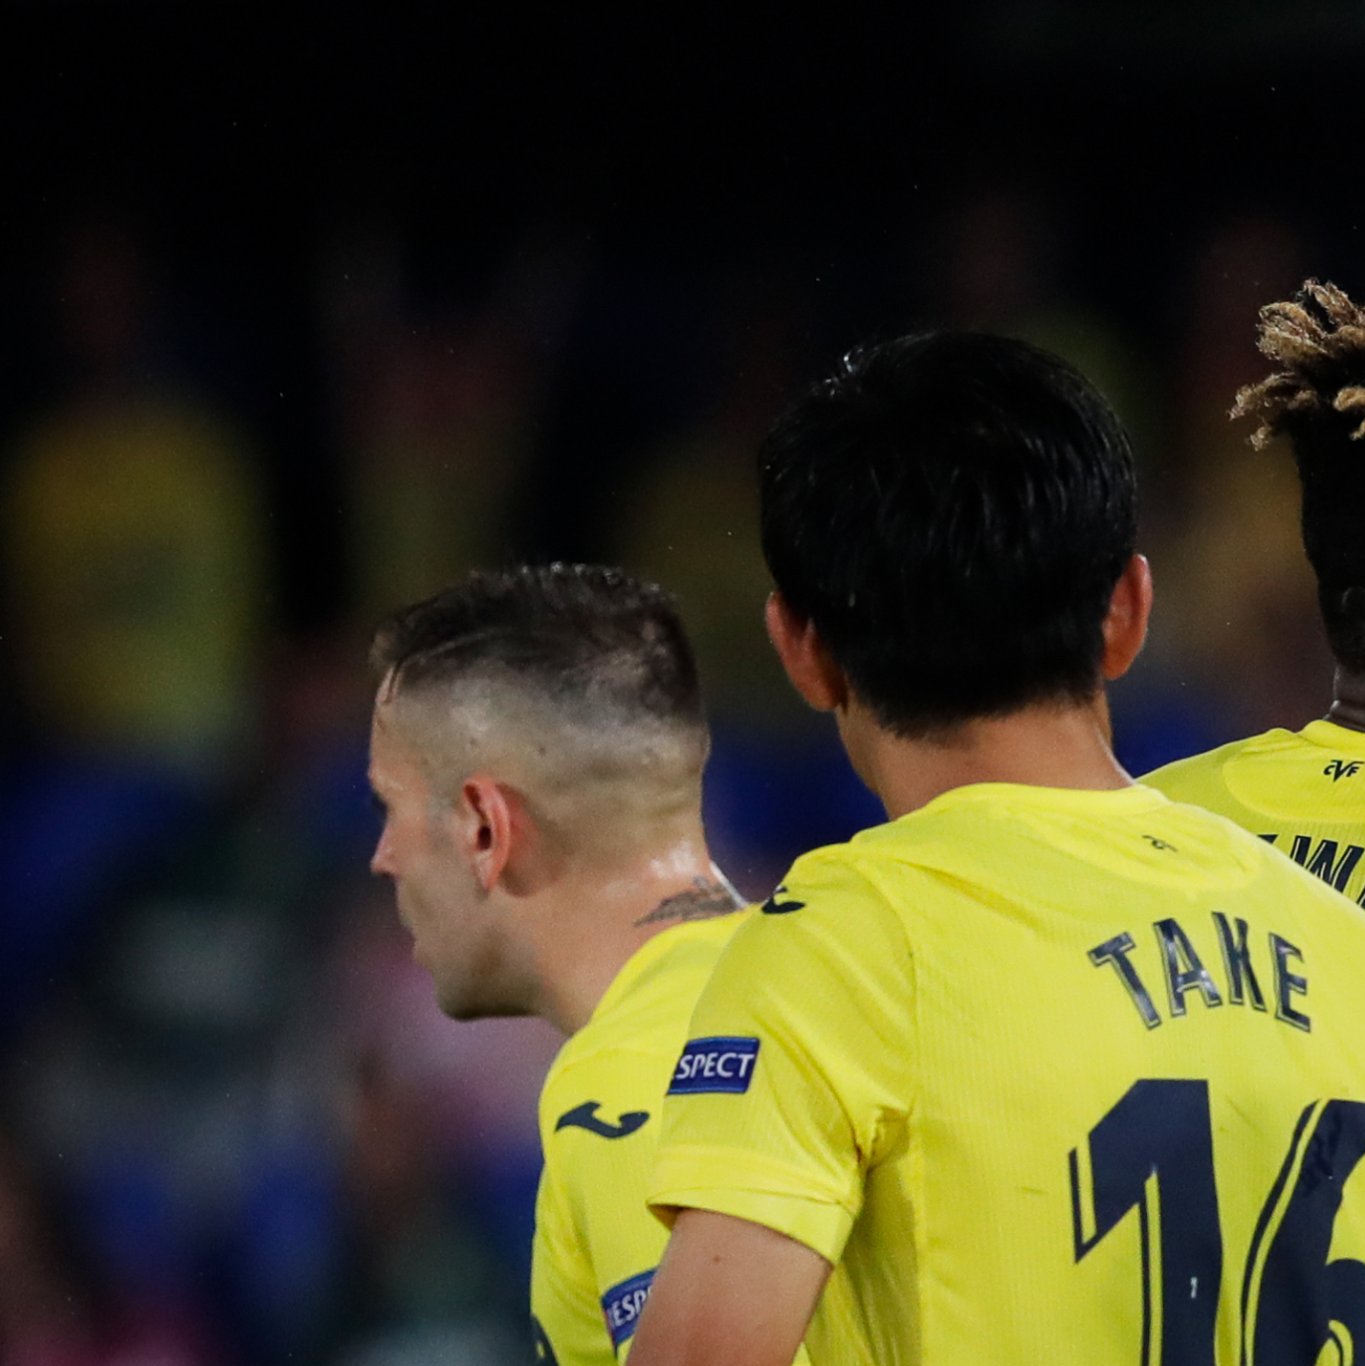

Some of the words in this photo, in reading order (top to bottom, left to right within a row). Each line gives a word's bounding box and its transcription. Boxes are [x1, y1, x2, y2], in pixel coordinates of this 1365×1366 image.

[1087, 911, 1312, 1034] TAKE
[675, 1051, 756, 1080] SPECT
[606, 1285, 653, 1330] ESP
